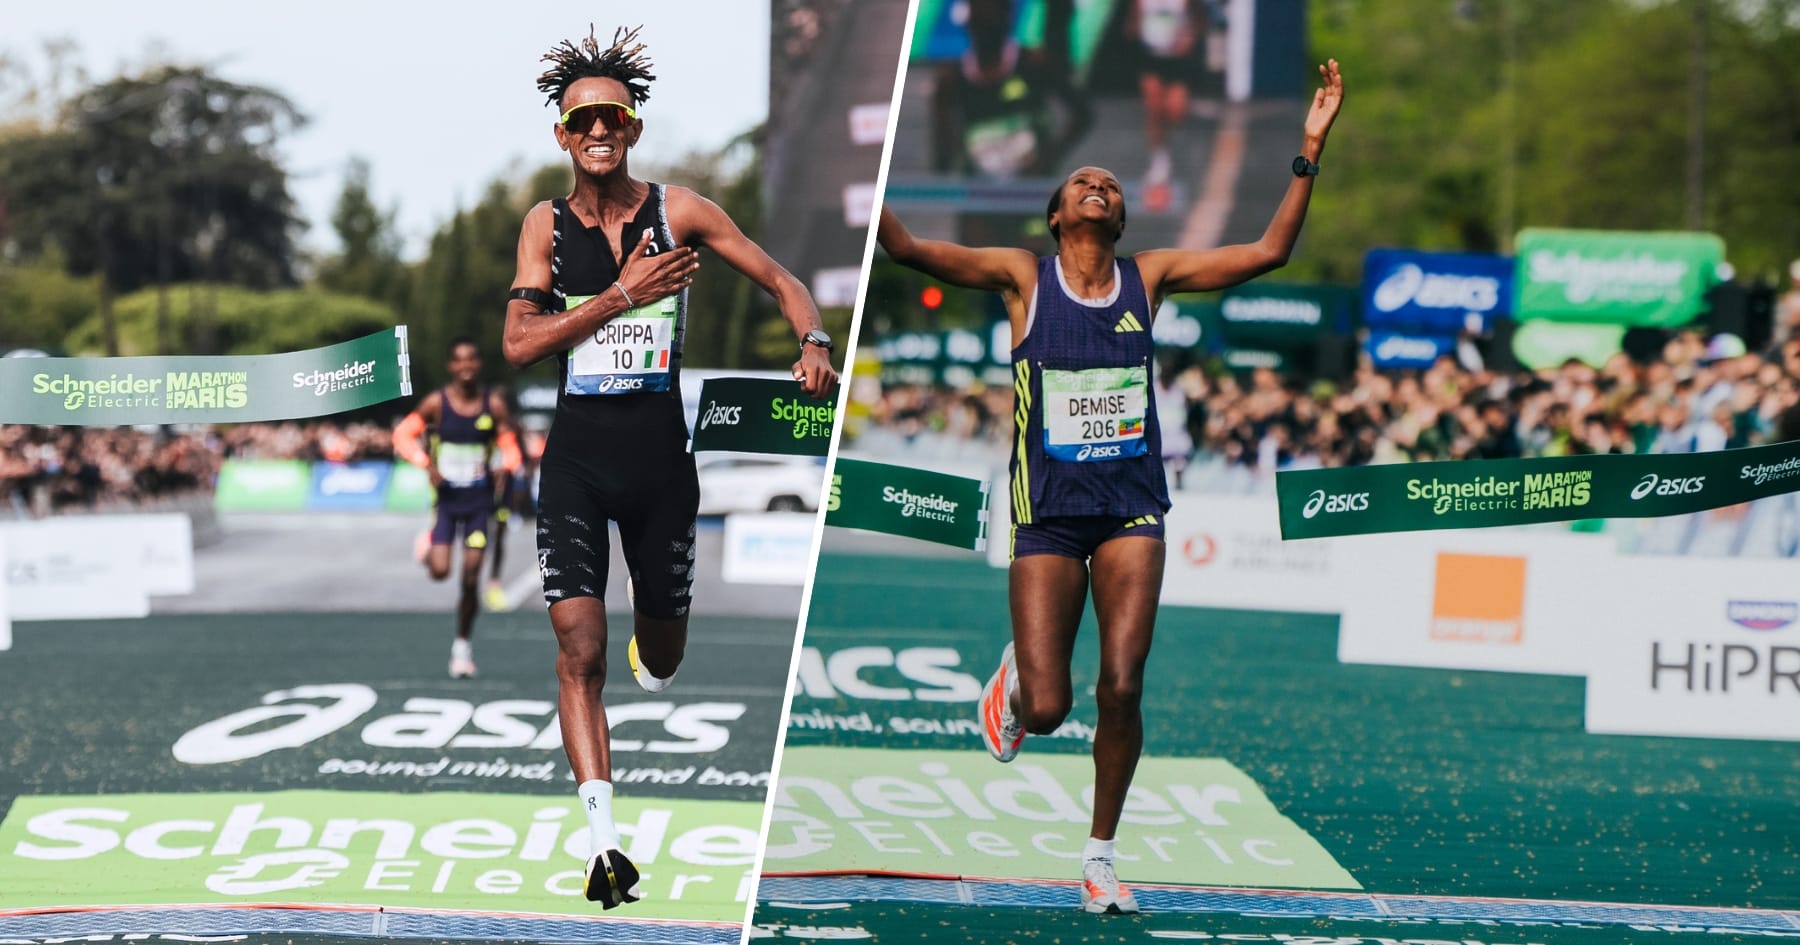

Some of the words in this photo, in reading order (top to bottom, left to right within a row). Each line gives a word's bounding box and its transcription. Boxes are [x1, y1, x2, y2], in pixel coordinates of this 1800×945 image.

[594, 324, 654, 345] CRIPPA
[612, 349, 633, 369] 10
[33, 373, 162, 395] Schneider
[166, 371, 247, 392] MARATHON
[293, 360, 376, 388] Schneider
[330, 375, 375, 392] Electric
[613, 378, 644, 390] asics
[88, 394, 159, 408] Electric
[174, 384, 248, 409] PARIS
[1069, 395, 1126, 416] DEMISE
[1082, 419, 1115, 439] 206
[1091, 445, 1121, 458] asics
[1407, 476, 1520, 500] Schneider
[1524, 470, 1592, 494] MARATHON
[1655, 476, 1706, 495] asics
[882, 486, 958, 513] Schneider
[1325, 492, 1370, 513] asics
[1454, 498, 1518, 512] Electric
[1530, 482, 1592, 509] PARIS
[916, 507, 956, 523] Electric
[889, 715, 983, 736] soun
[317, 757, 449, 777] sound
[447, 757, 557, 782] mind,
[566, 765, 697, 784] und
[13, 802, 760, 867] Schneide
